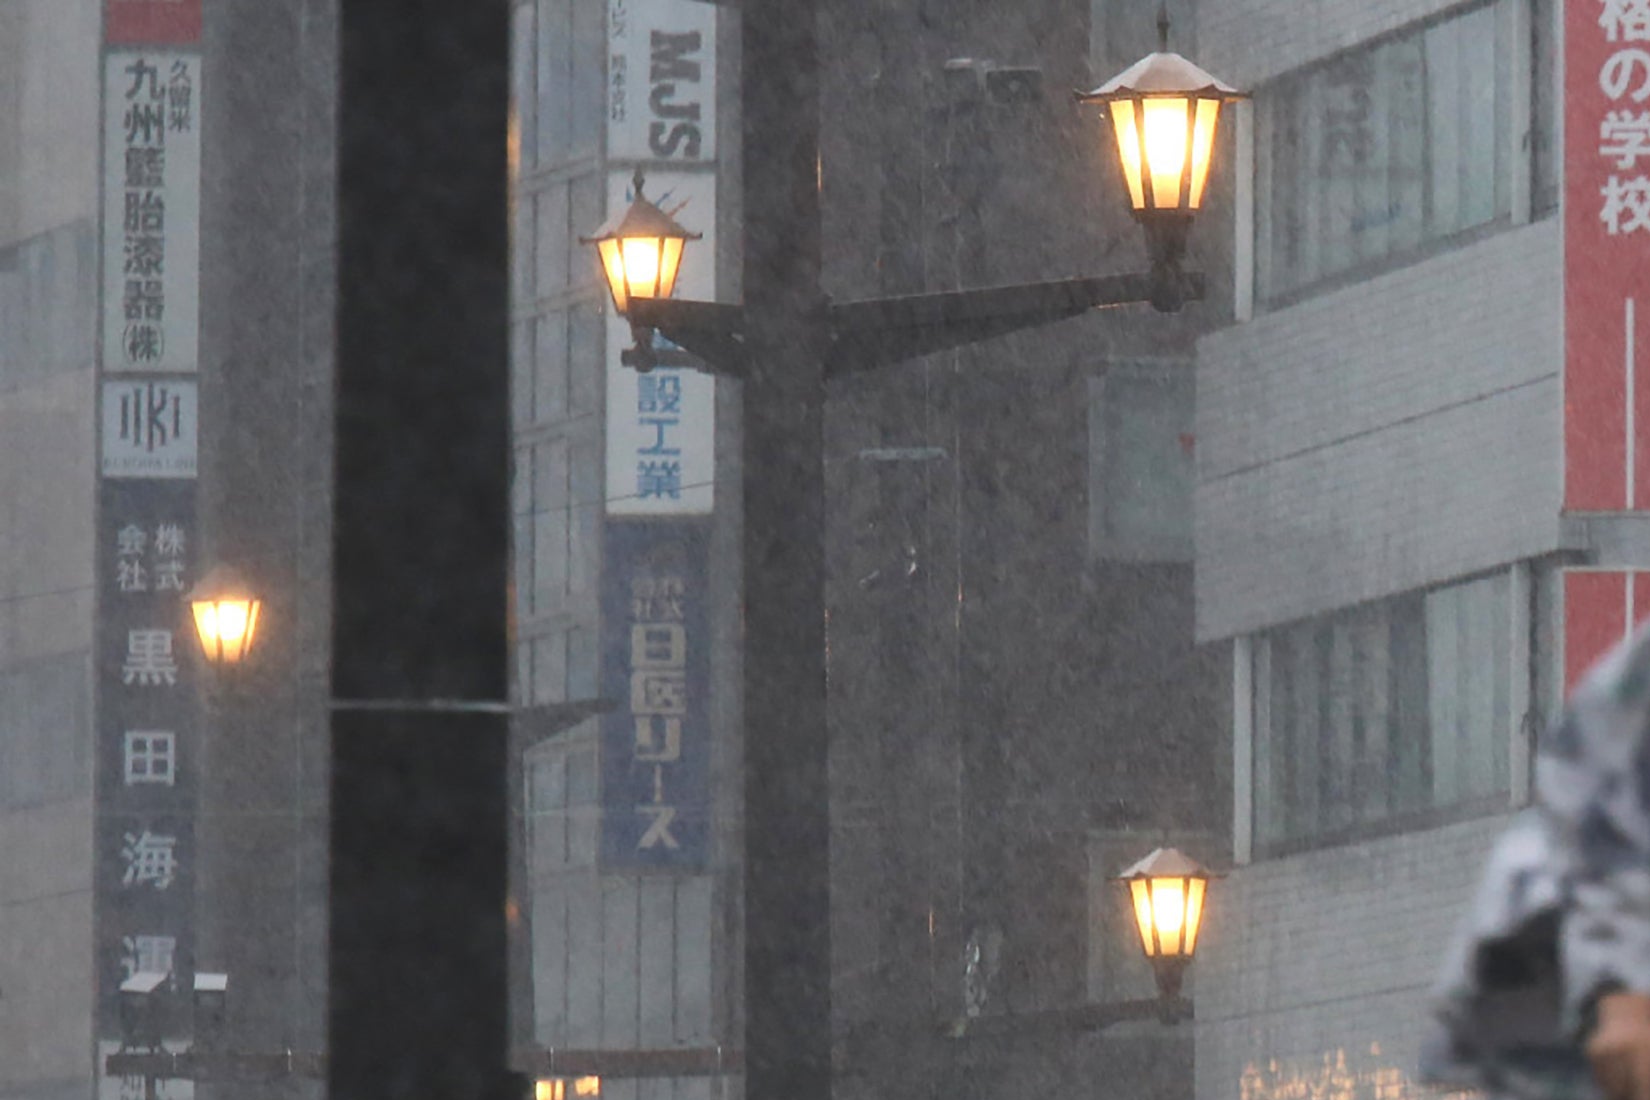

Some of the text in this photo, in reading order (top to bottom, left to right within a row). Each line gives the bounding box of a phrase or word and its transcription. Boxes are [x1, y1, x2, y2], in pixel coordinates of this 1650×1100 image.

[169, 60, 191, 133] 久留米
[649, 29, 702, 158] MJS
[637, 335, 682, 500] 設工業
